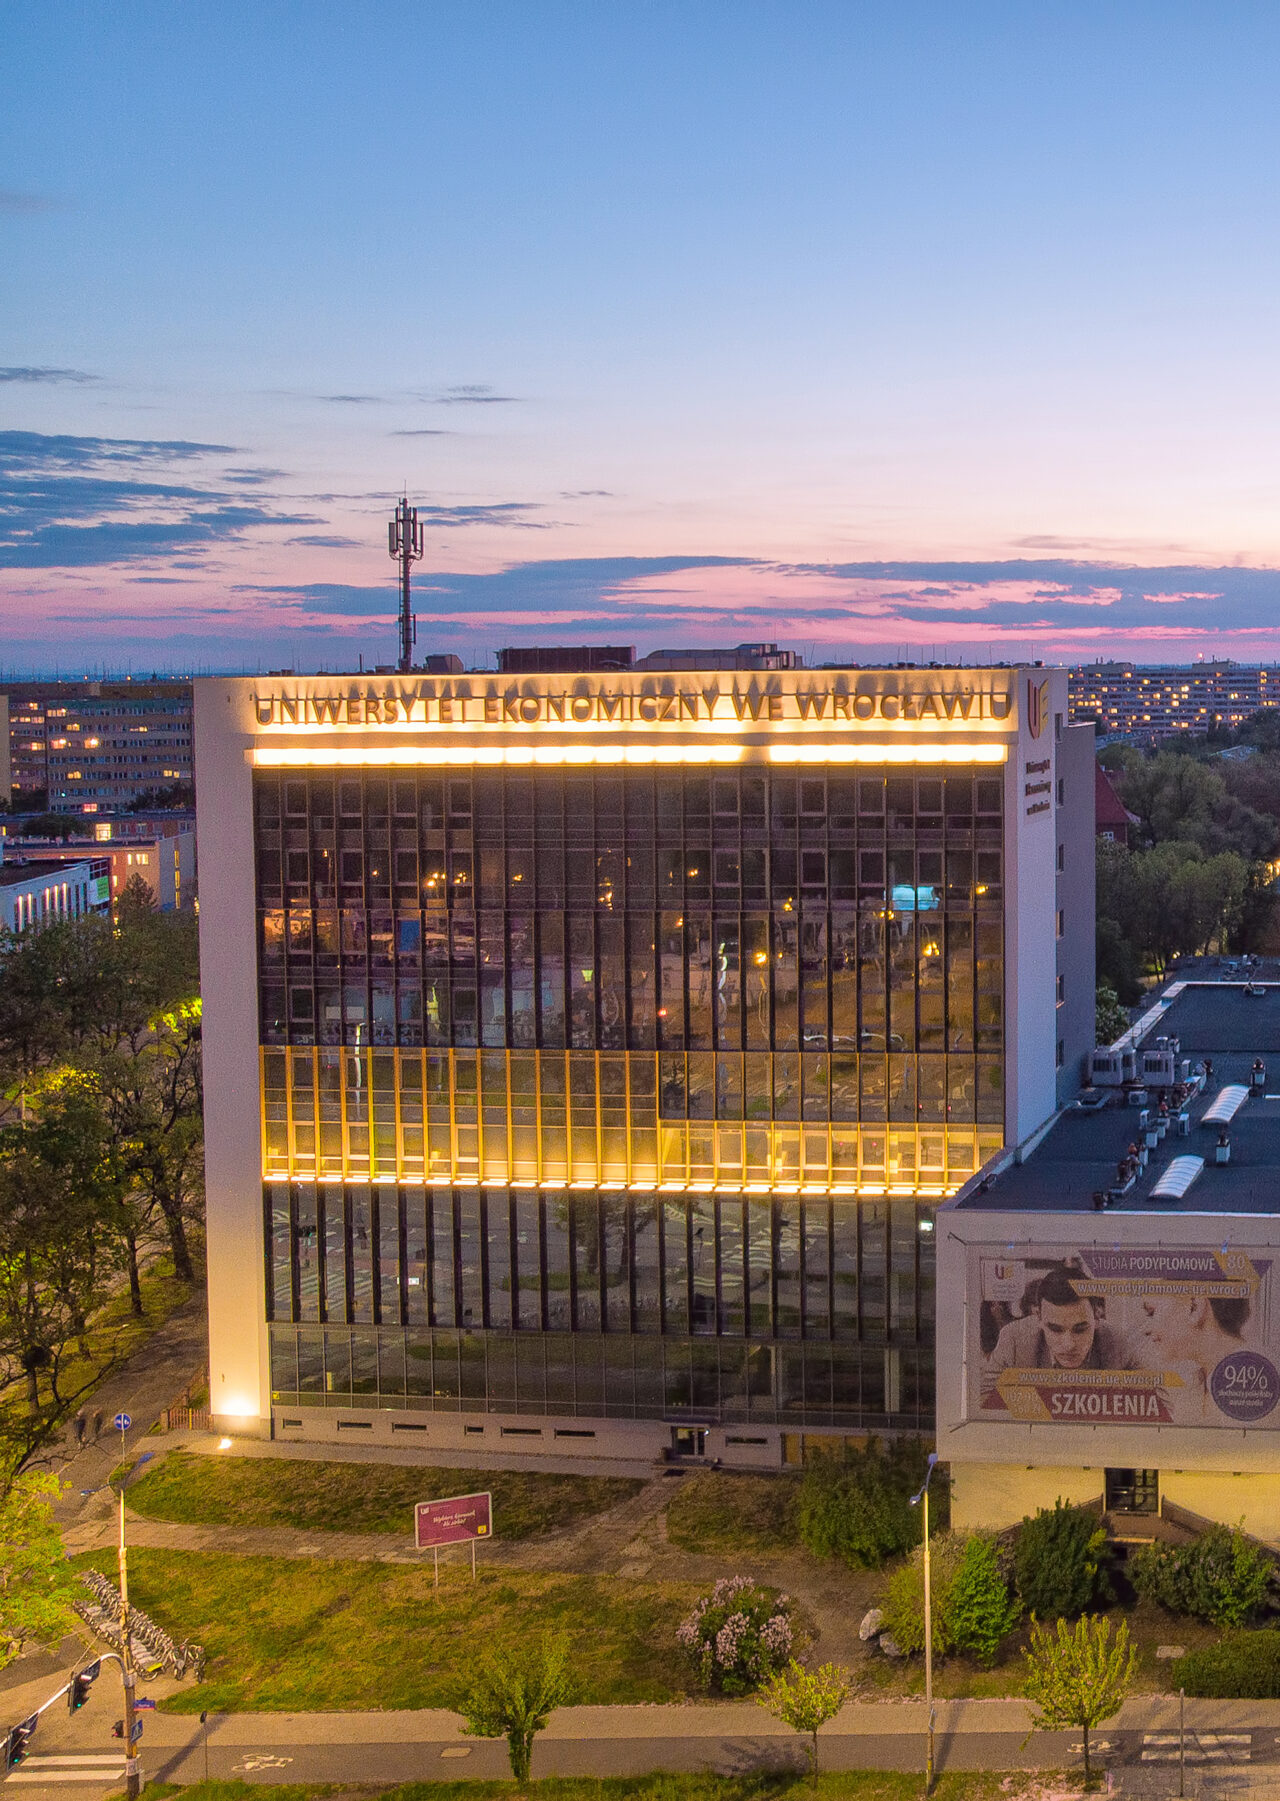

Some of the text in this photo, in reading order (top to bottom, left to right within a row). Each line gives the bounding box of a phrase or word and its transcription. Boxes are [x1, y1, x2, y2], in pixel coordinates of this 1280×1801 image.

[255, 692, 1012, 726] UNIWERSYTET EKONOMICZNY WE WROCŁAWIU
[1091, 1256, 1216, 1271] STUDIA PODYPLOMOWE
[1224, 1365, 1268, 1390] 94%
[1051, 1393, 1160, 1416] SZKOLENIA
